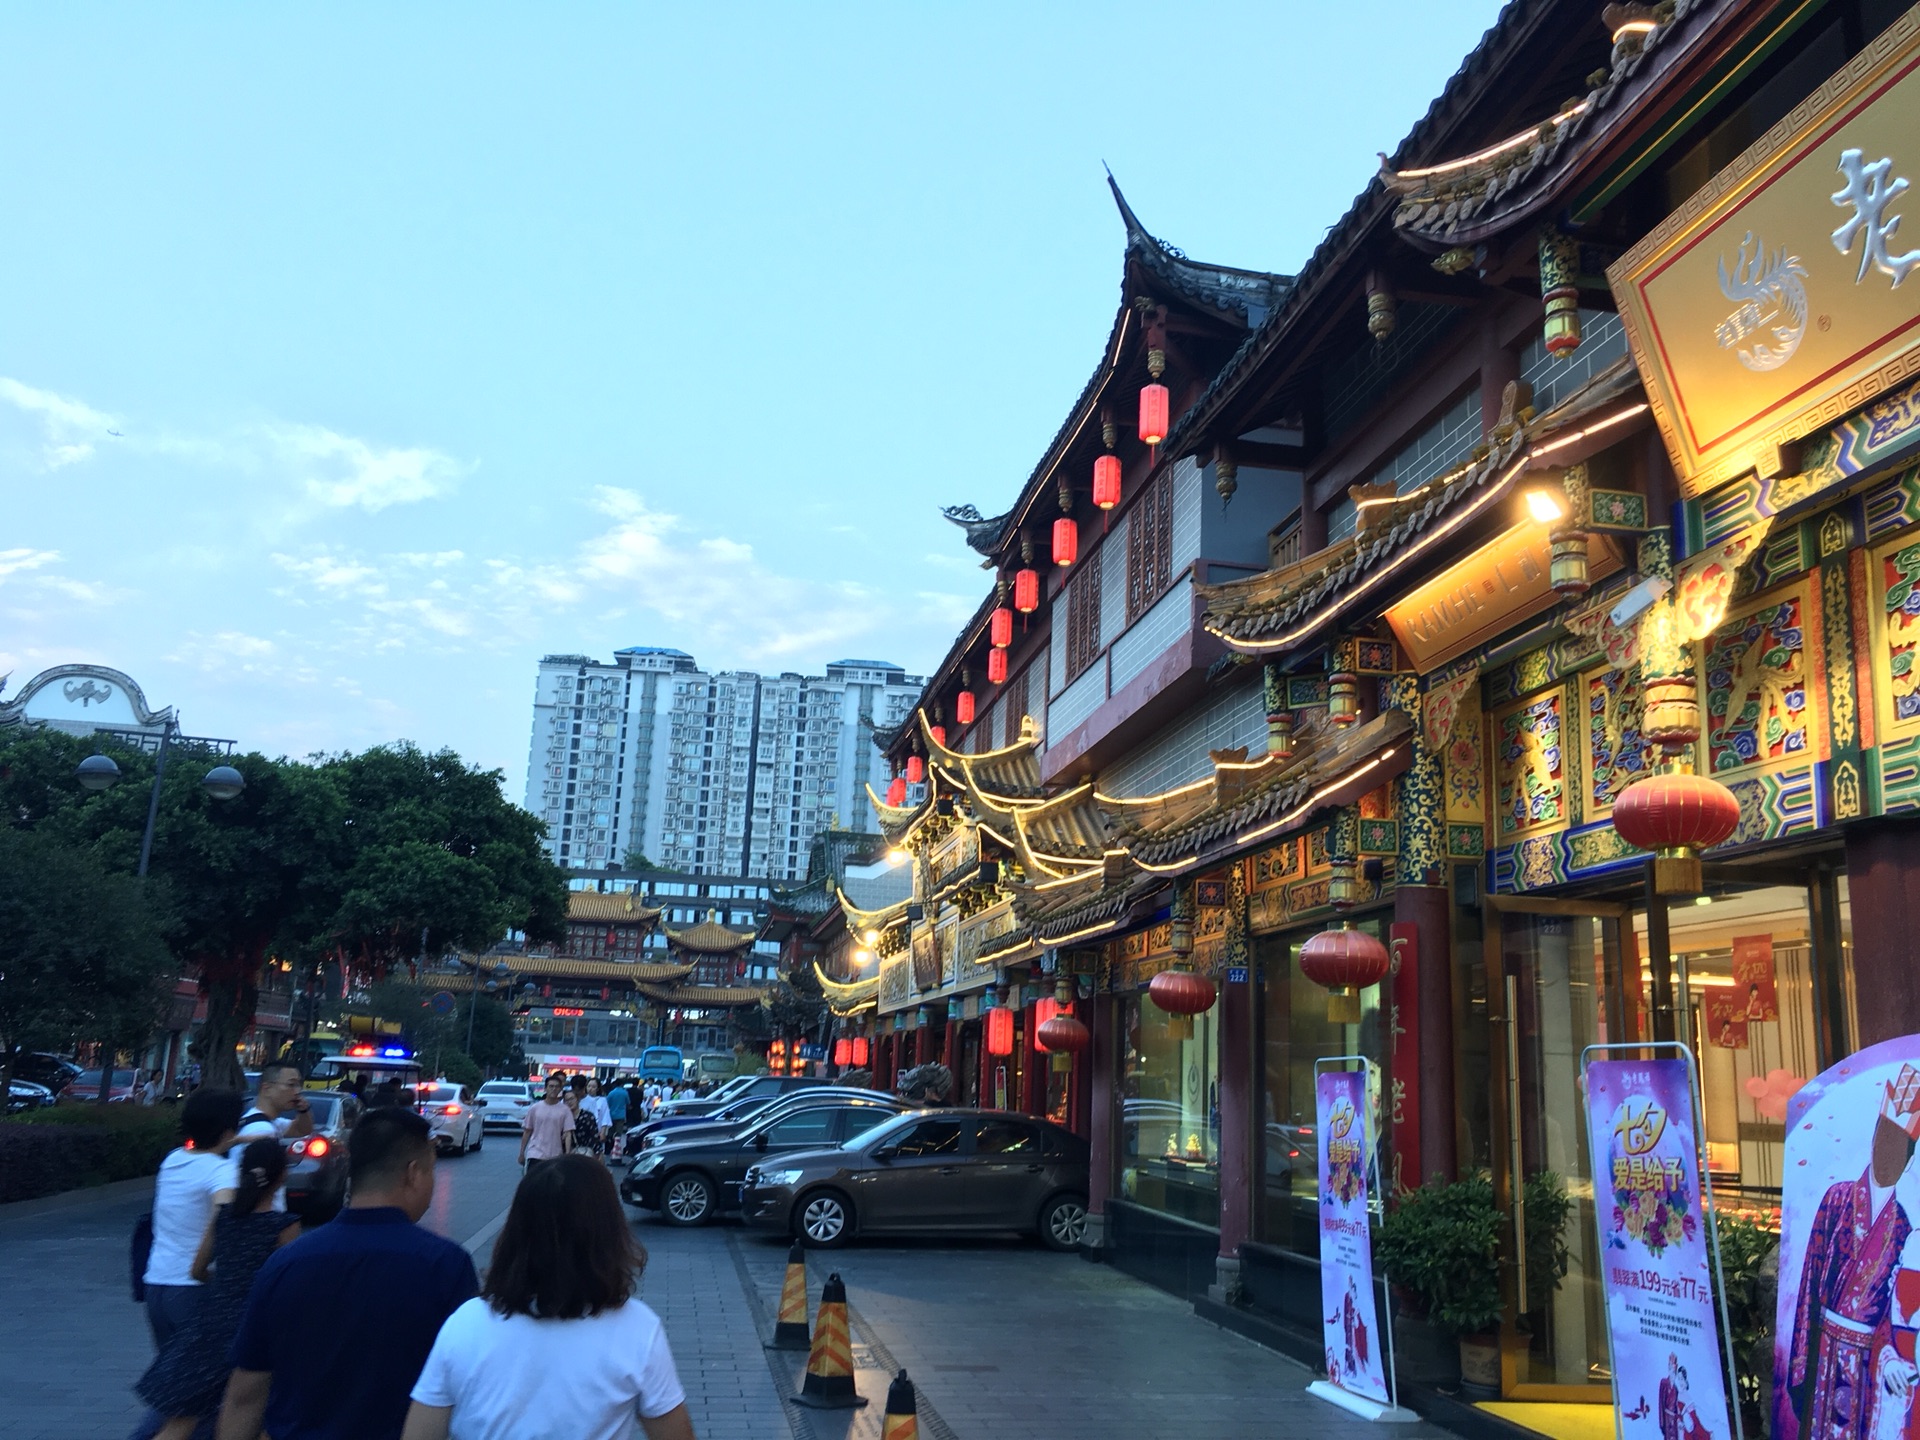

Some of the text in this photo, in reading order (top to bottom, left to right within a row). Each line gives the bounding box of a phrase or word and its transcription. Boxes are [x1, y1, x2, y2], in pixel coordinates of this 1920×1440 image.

[1830, 148, 1920, 290] 老
[1330, 1101, 1355, 1139] 七夕
[1614, 1101, 1668, 1156] 七夕
[1329, 1140, 1361, 1164] 爱是给予
[1613, 1157, 1684, 1192] 爱是给予
